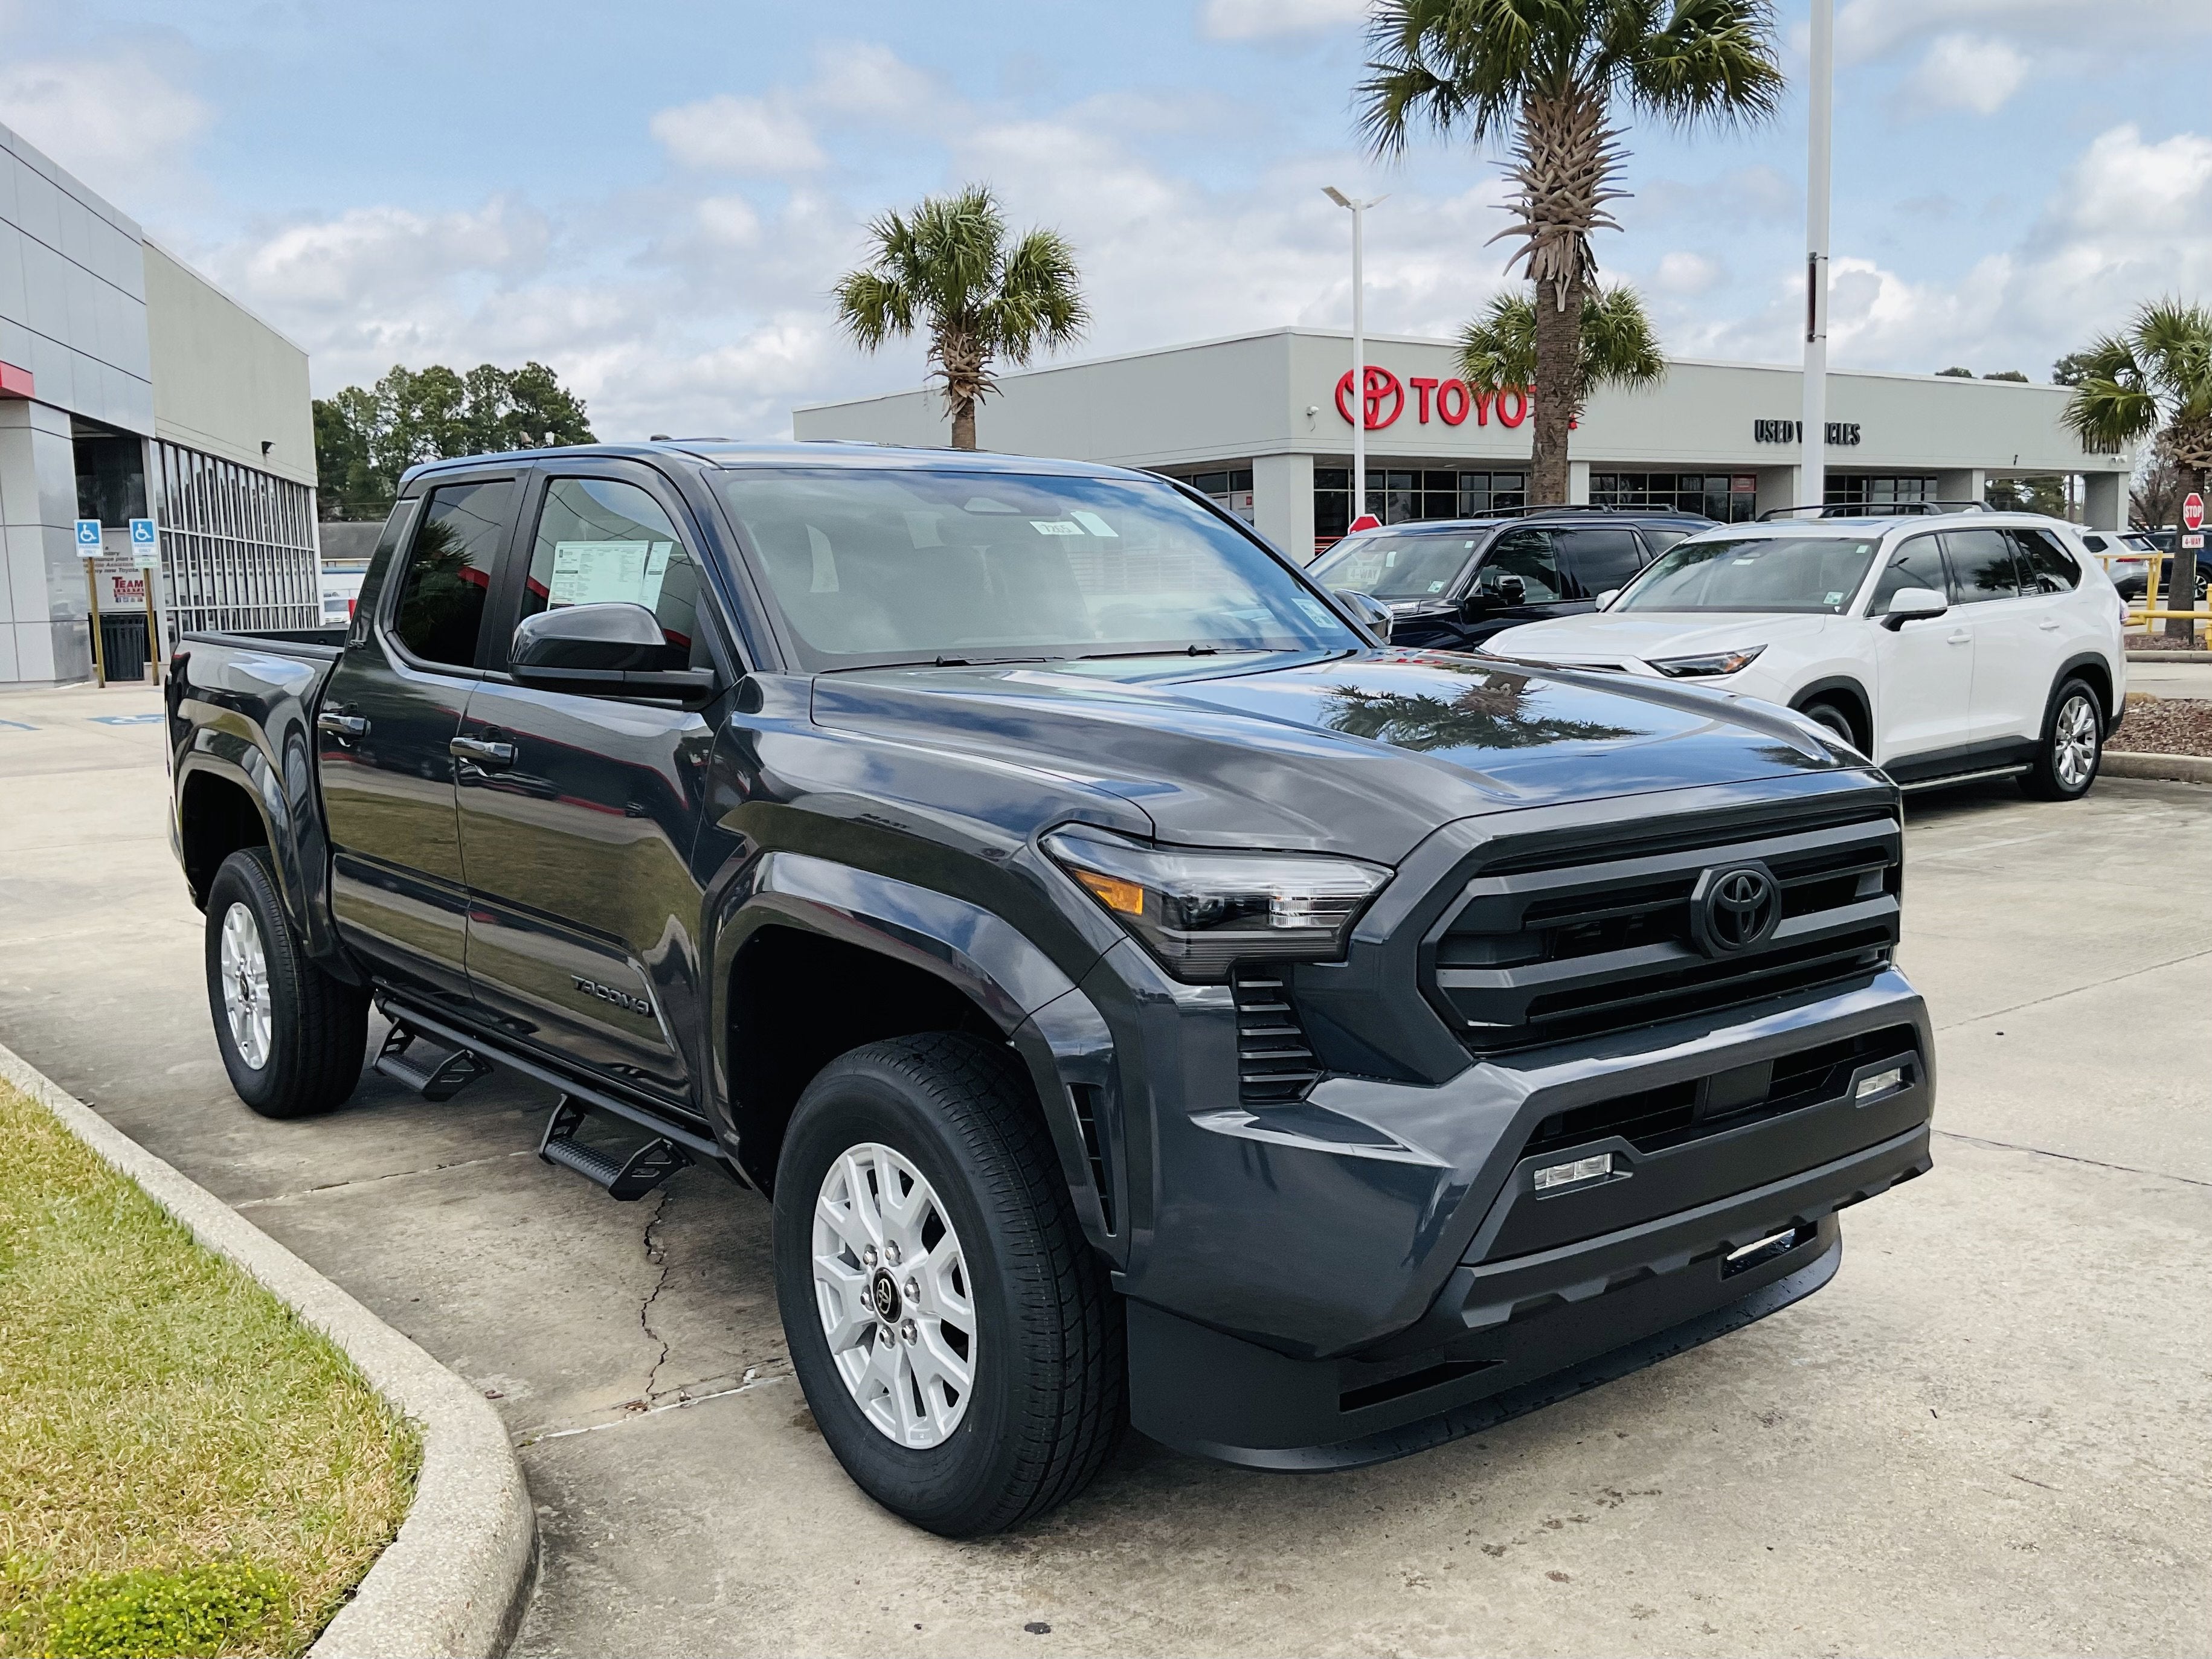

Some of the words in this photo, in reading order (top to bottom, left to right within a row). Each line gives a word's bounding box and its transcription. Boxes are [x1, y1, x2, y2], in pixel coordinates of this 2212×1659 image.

[1410, 377, 1578, 429] TOYO
[1755, 420, 1794, 443] USED
[2185, 505, 2202, 518] STOP
[112, 576, 143, 588] TEAM
